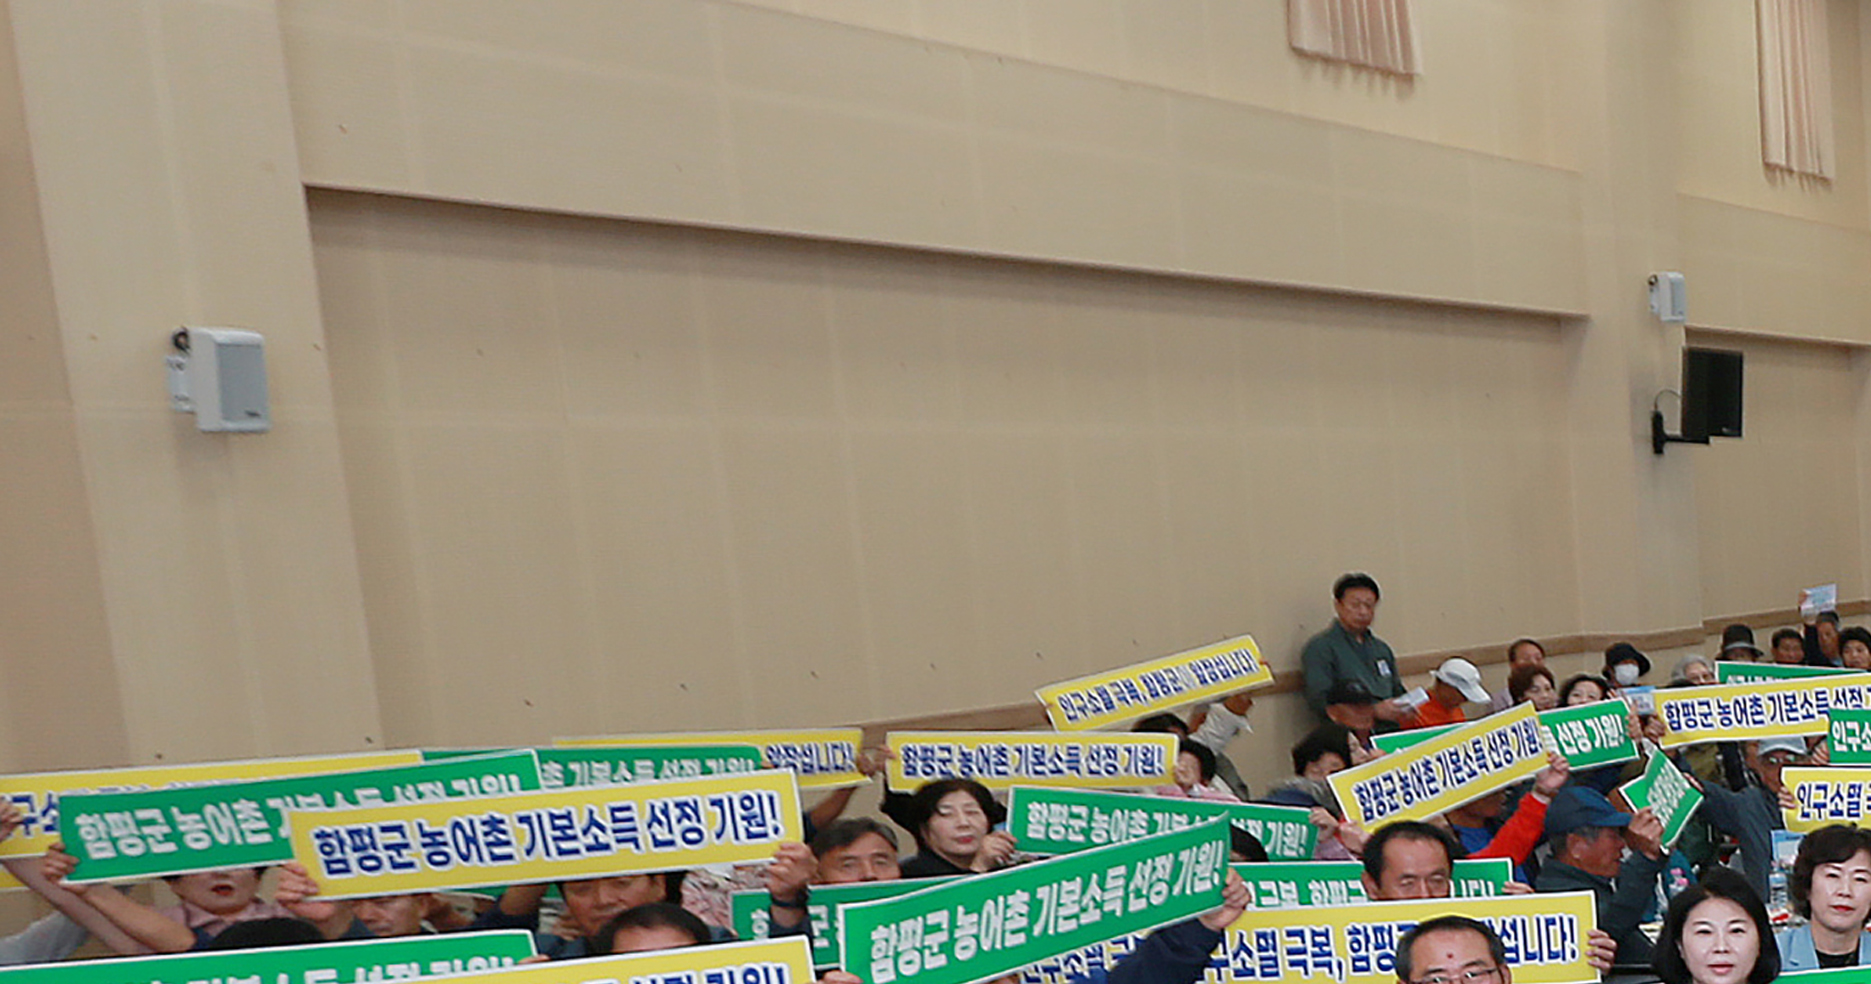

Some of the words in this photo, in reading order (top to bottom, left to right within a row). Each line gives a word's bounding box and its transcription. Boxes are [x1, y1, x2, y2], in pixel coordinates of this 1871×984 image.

[1556, 718, 1592, 756] 선정
[1591, 713, 1626, 749] 기원!
[1665, 701, 1714, 731] 함평군
[1717, 697, 1767, 727] 농어촌
[1767, 690, 1831, 722] 기본소득
[903, 743, 953, 778] 함평군
[957, 747, 1010, 777] 농어촌
[1014, 747, 1084, 777] 기본소득
[1086, 748, 1119, 776] 선정
[1123, 747, 1164, 776] 기원!
[1353, 775, 1401, 824] 함평군
[1395, 757, 1442, 808] 농어촌
[1437, 734, 1492, 787] 기본소득
[1795, 782, 1860, 818] 인구소멸
[74, 805, 179, 861] 함평군
[171, 798, 274, 852] 농어촌
[314, 818, 412, 879] 함평군
[414, 811, 514, 868] 농어촌
[517, 801, 641, 859] 기본소득
[645, 795, 707, 850] 선정
[713, 791, 784, 842] 기원!
[1026, 801, 1080, 843] 함평군
[1263, 816, 1308, 858] 기원!
[871, 908, 949, 984] 함평군
[954, 889, 1031, 961] 농어촌
[1033, 865, 1128, 936] 기본소득
[1129, 860, 1176, 907] 선정
[1177, 840, 1226, 897] 기원!
[1282, 926, 1344, 984] 극복,
